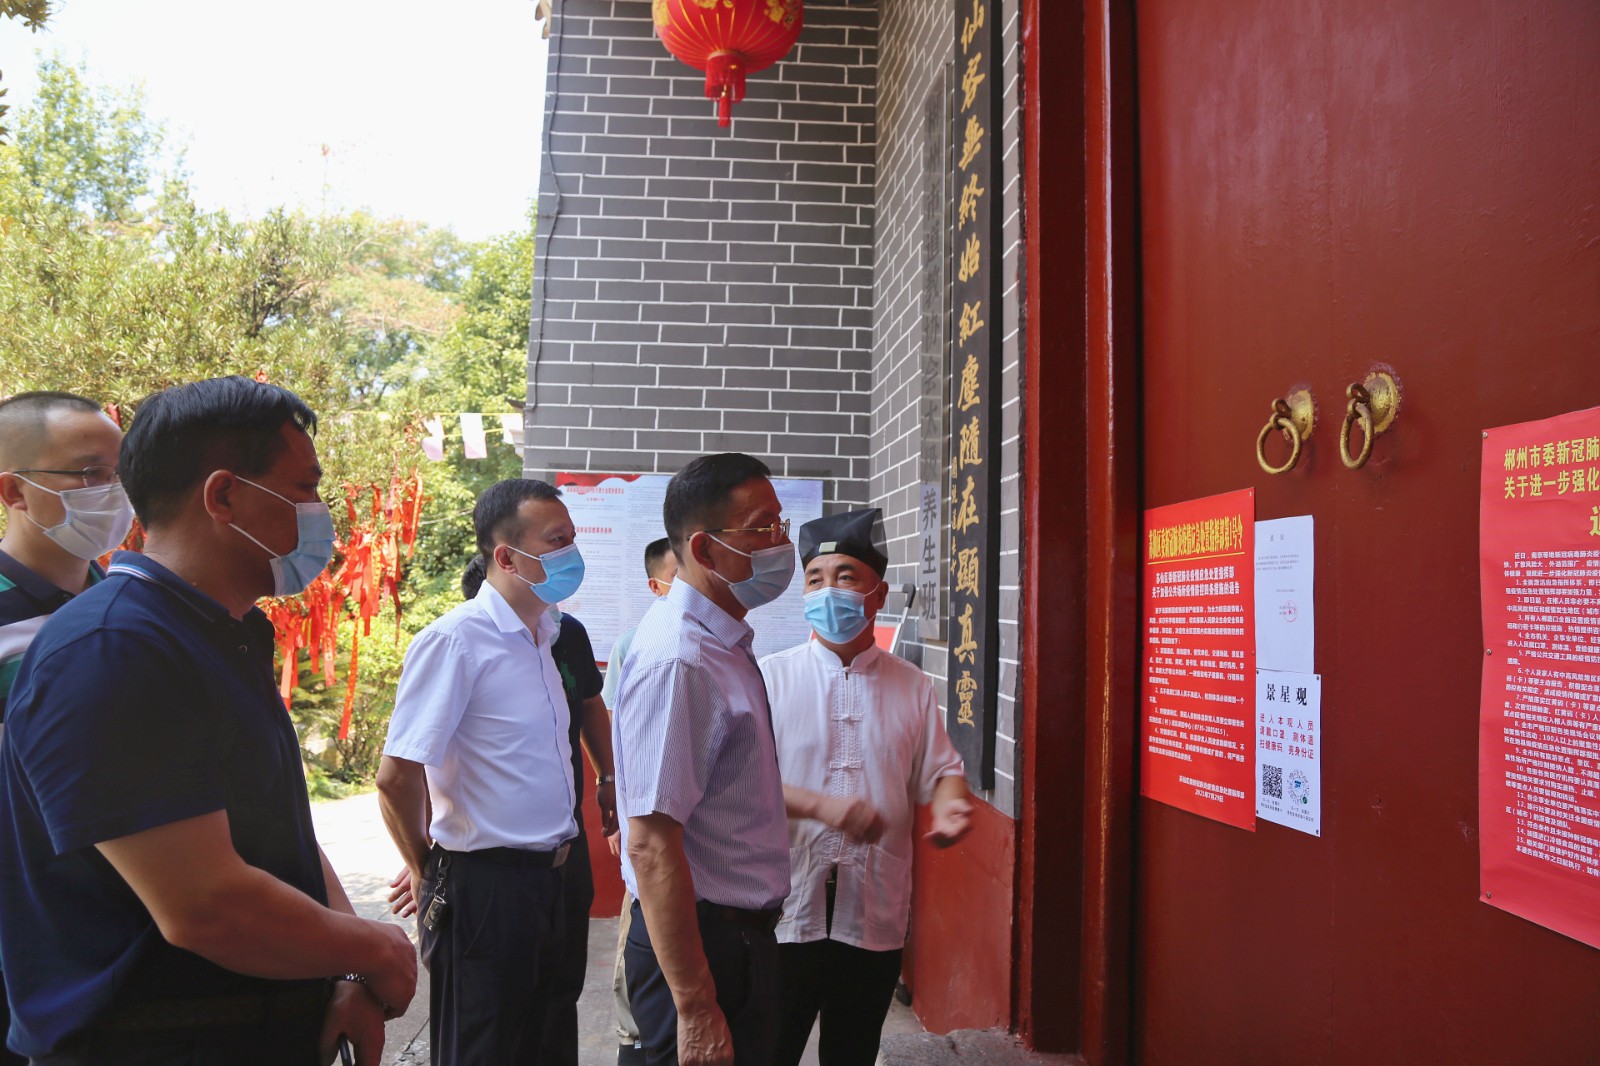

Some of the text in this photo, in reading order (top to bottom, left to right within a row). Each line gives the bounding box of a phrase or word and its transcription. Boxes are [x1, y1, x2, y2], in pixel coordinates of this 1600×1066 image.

[1504, 436, 1599, 470] 郴州市委新冠肺
[1504, 467, 1599, 499] 关于进一步强化
[1266, 683, 1307, 706] 景星观
